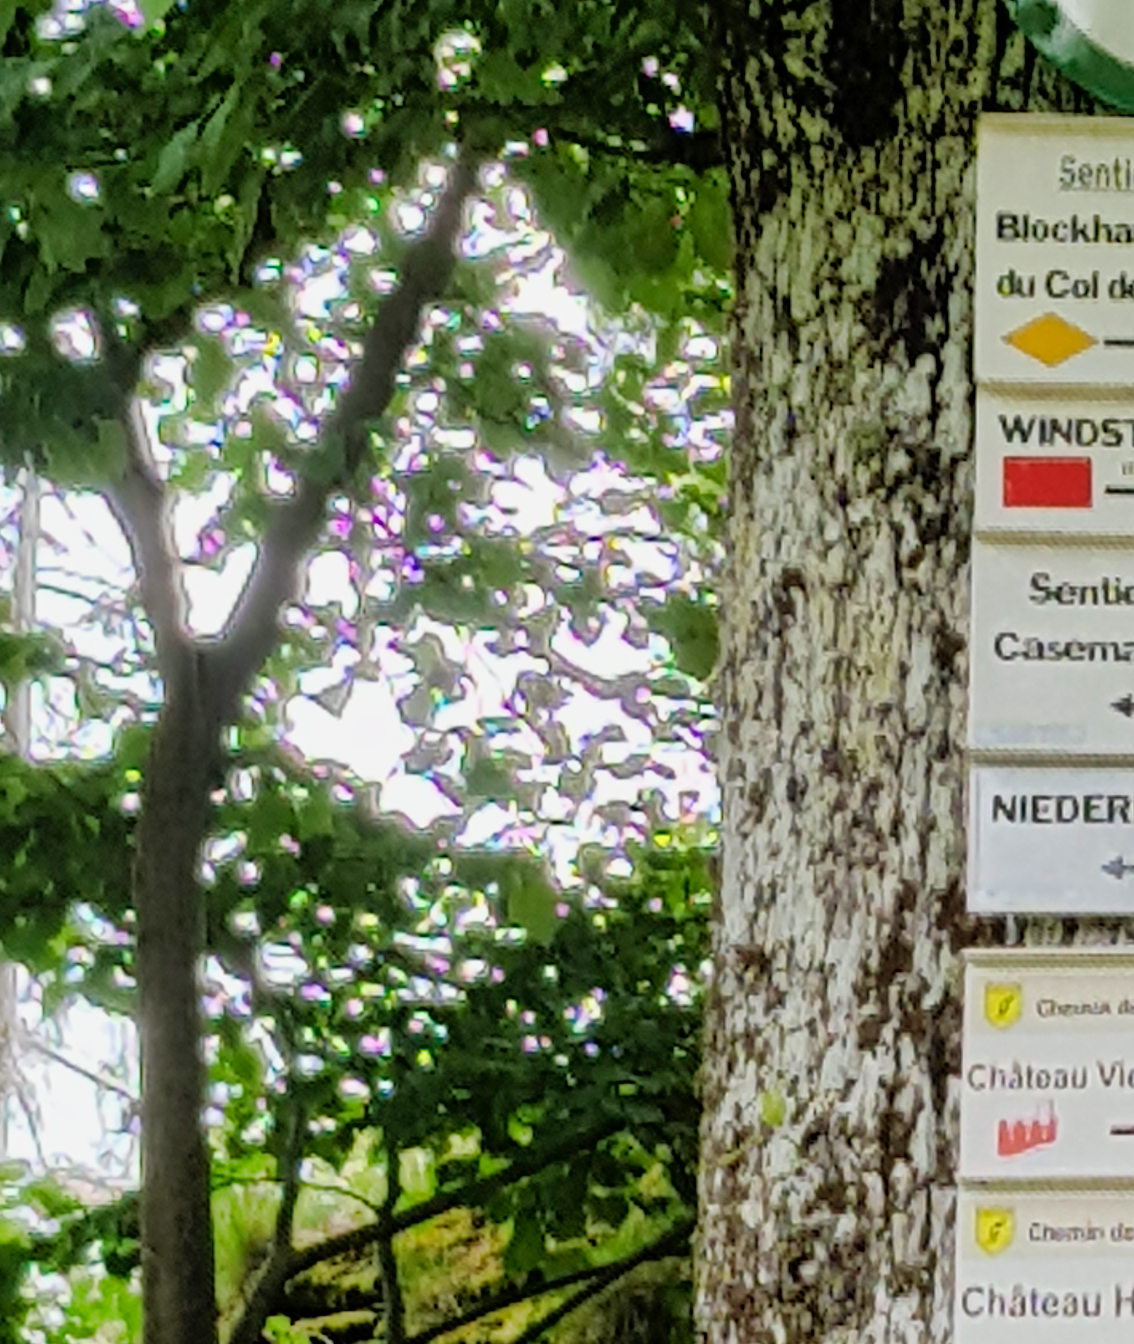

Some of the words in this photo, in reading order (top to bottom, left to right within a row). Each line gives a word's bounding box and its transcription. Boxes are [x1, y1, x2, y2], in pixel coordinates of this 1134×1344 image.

[997, 269, 1035, 298] du
[1046, 269, 1098, 299] Col
[967, 1062, 1088, 1091] Château
[1029, 1219, 1105, 1242] Chemin
[961, 1284, 1102, 1319] Château
